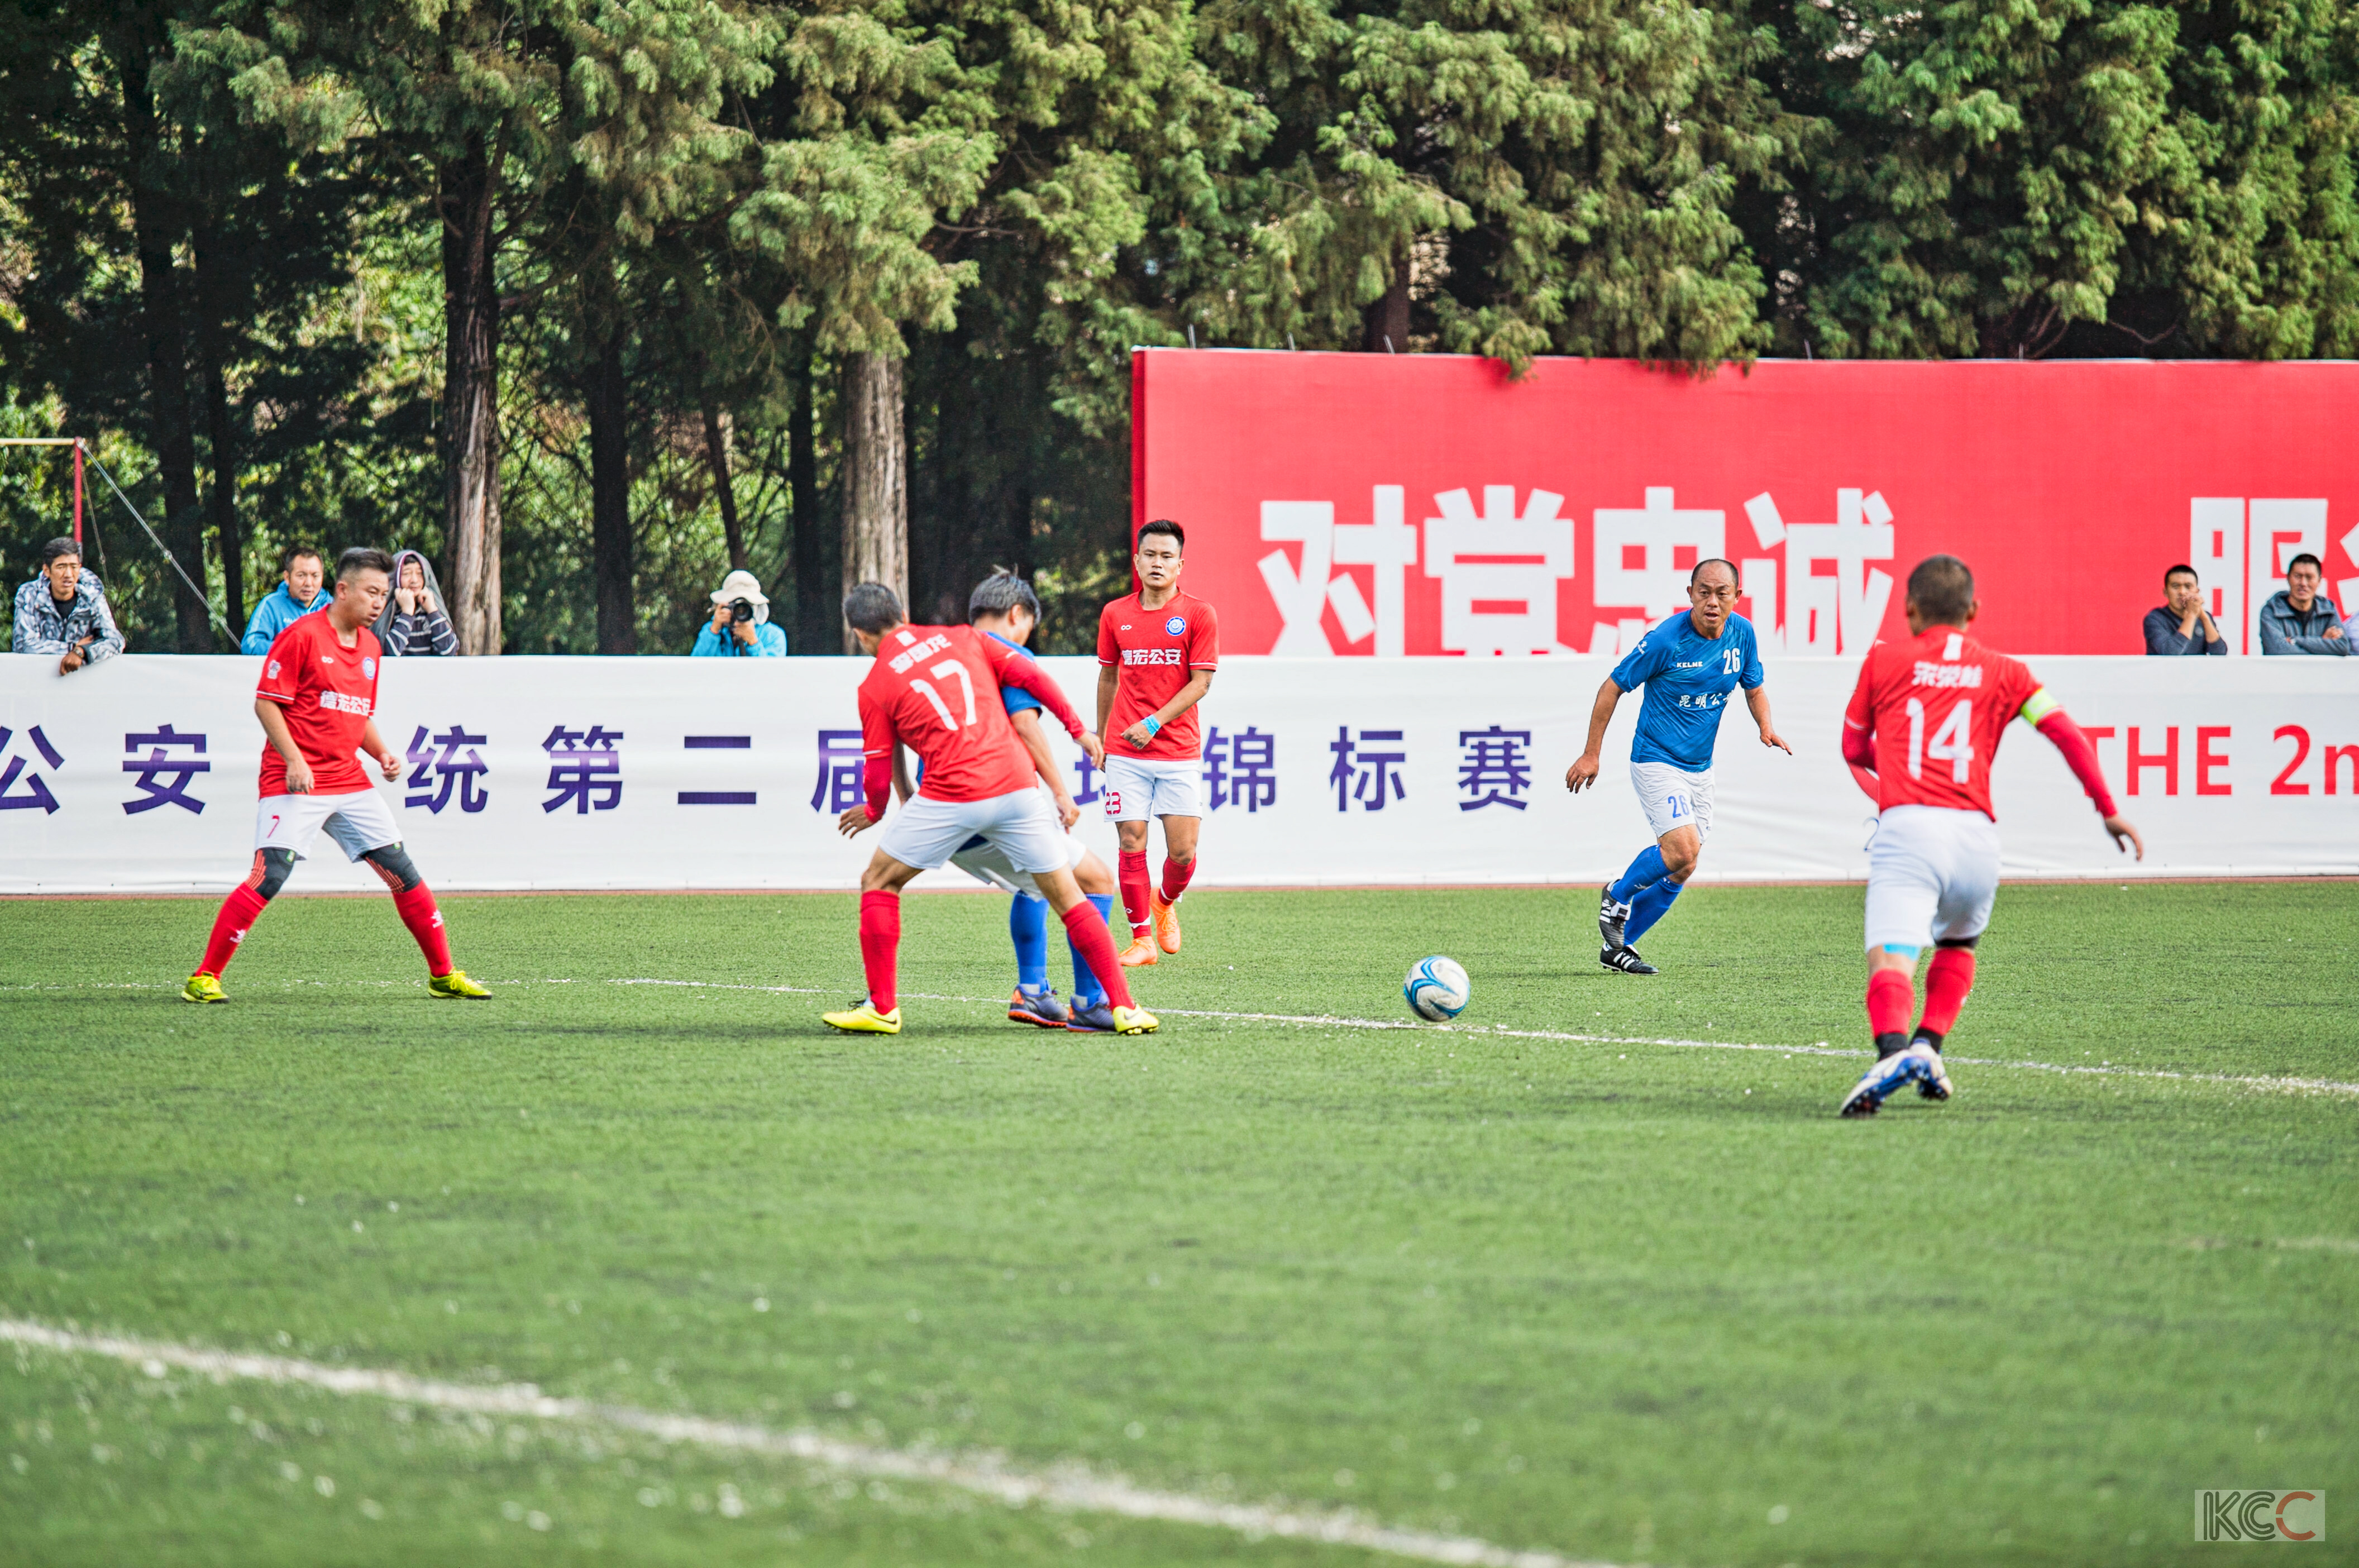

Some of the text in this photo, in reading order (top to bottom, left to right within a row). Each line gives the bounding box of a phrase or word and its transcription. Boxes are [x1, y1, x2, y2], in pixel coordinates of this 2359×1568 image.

[2191, 498, 2359, 655] 服
[1723, 648, 1740, 675] 26
[909, 659, 977, 731] 17
[1906, 697, 1974, 785] 14
[1105, 792, 1121, 815] 23
[1668, 795, 1690, 818] 26
[267, 815, 280, 838] 7
